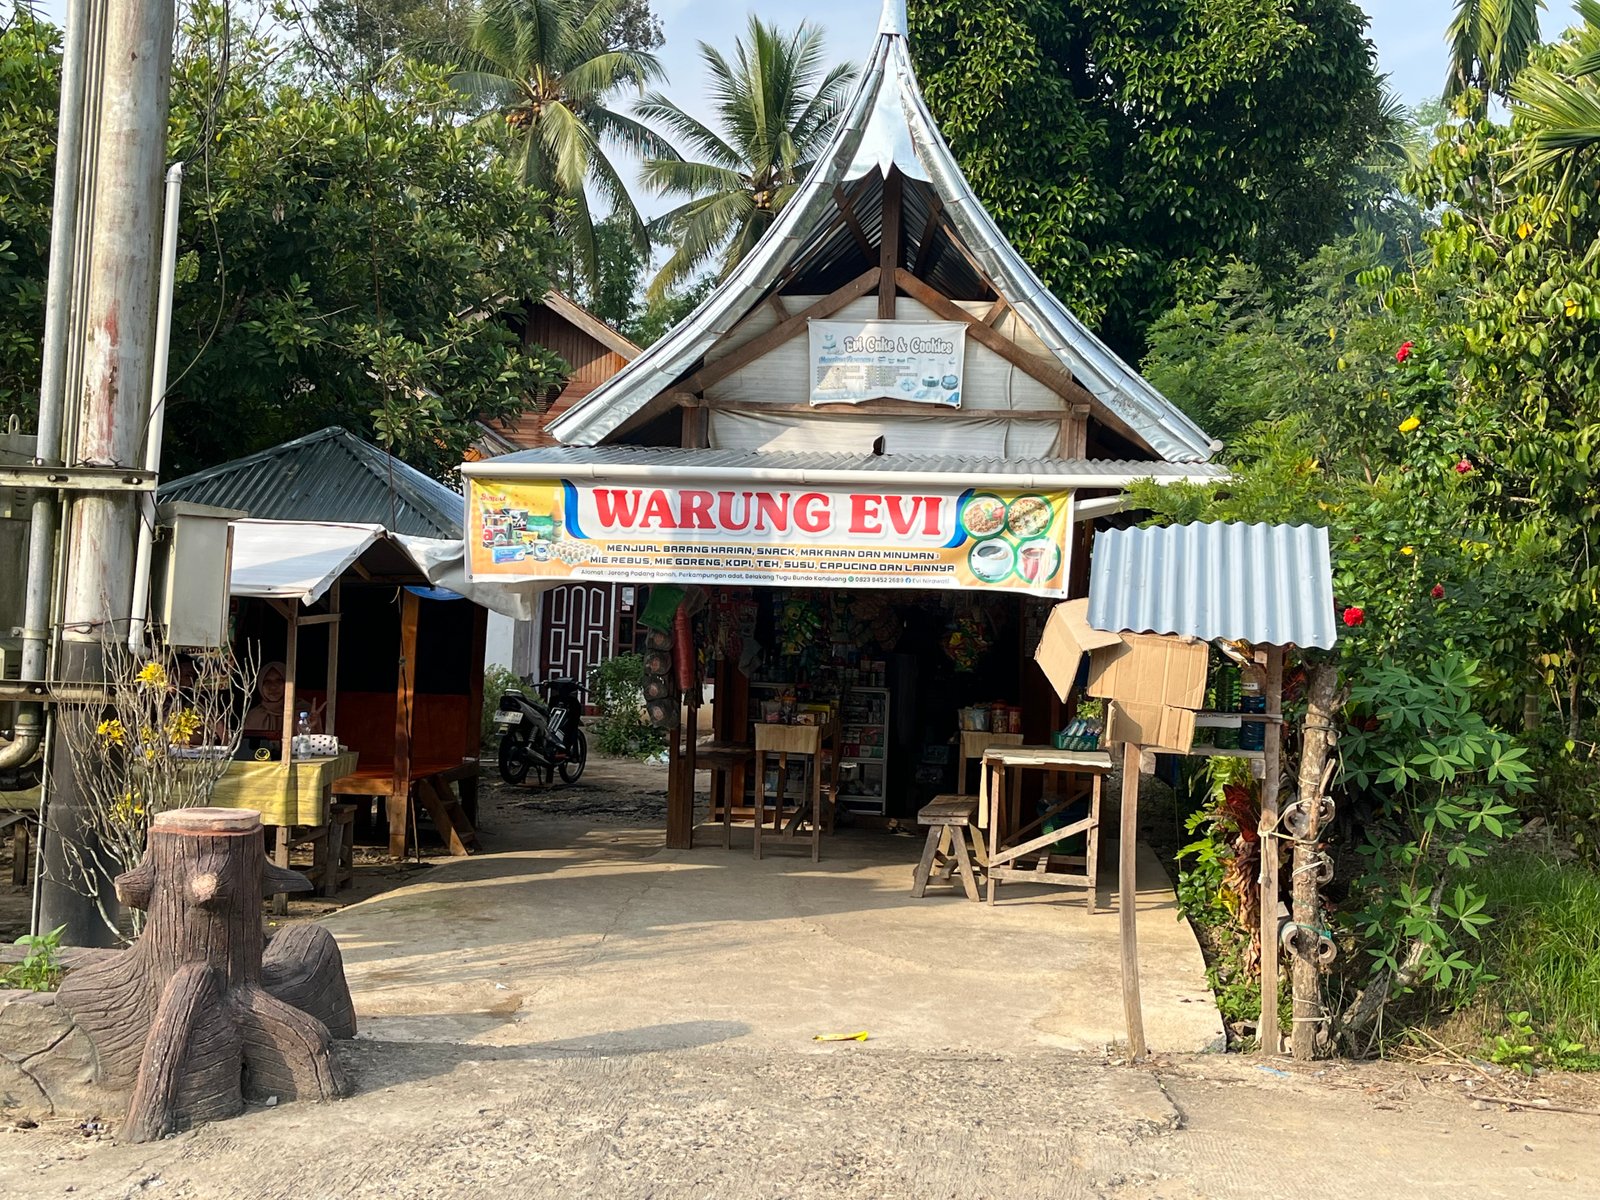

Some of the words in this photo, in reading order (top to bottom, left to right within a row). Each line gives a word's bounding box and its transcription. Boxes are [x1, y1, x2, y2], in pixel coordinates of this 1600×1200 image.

[844, 336, 863, 353] Evi
[865, 336, 894, 353] Cake
[897, 337, 907, 353] &
[910, 337, 953, 354] Cookies
[593, 489, 830, 533] WARUNG
[848, 494, 942, 535] EVI
[607, 544, 660, 553] MENJUAL
[663, 545, 708, 554] BARANG
[711, 546, 755, 556] HARIAN,
[757, 547, 798, 557] SNACK,
[800, 549, 855, 558] MAKANAN
[858, 550, 881, 558] DAN
[884, 551, 934, 560] MINUMAN
[590, 556, 608, 564] MIE
[611, 557, 653, 566] REBUS,
[675, 558, 724, 568] GORENG,
[725, 559, 754, 568] KOPI,
[757, 560, 782, 569] TEH,
[784, 561, 818, 570] SUSU,
[820, 562, 877, 571] CAPUCINO
[880, 564, 902, 572] DAN
[905, 564, 955, 572] LAINNYA
[678, 572, 726, 580] Perkampungan
[814, 575, 847, 583] Kanduang
